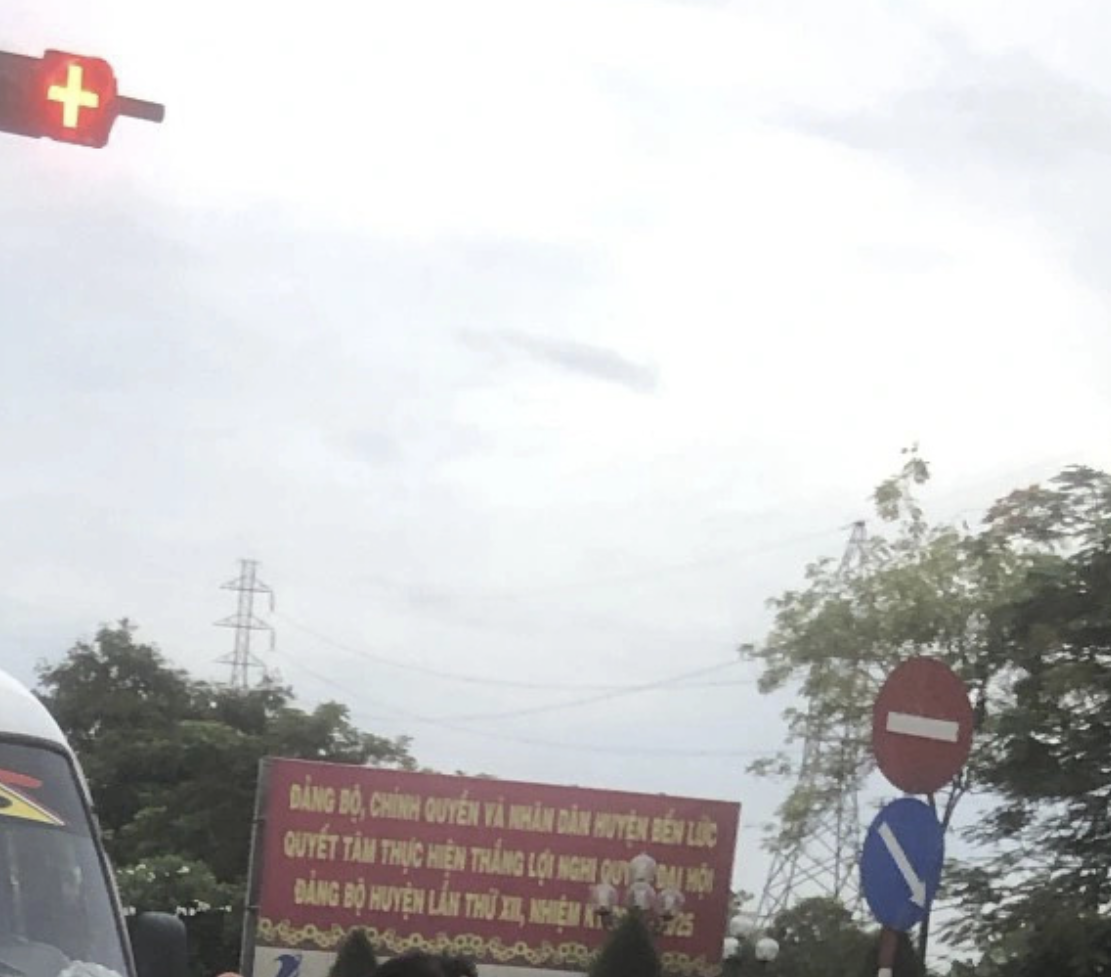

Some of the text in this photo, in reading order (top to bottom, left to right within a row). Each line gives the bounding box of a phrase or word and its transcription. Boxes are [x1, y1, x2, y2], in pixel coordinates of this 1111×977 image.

[290, 775, 336, 814] ĐẢNG
[370, 787, 420, 822] CHÍNH
[284, 823, 339, 860] QUYẾT
[342, 831, 377, 864] TÂM
[294, 869, 340, 906] ĐẢNG
[343, 877, 366, 917] BỘ
